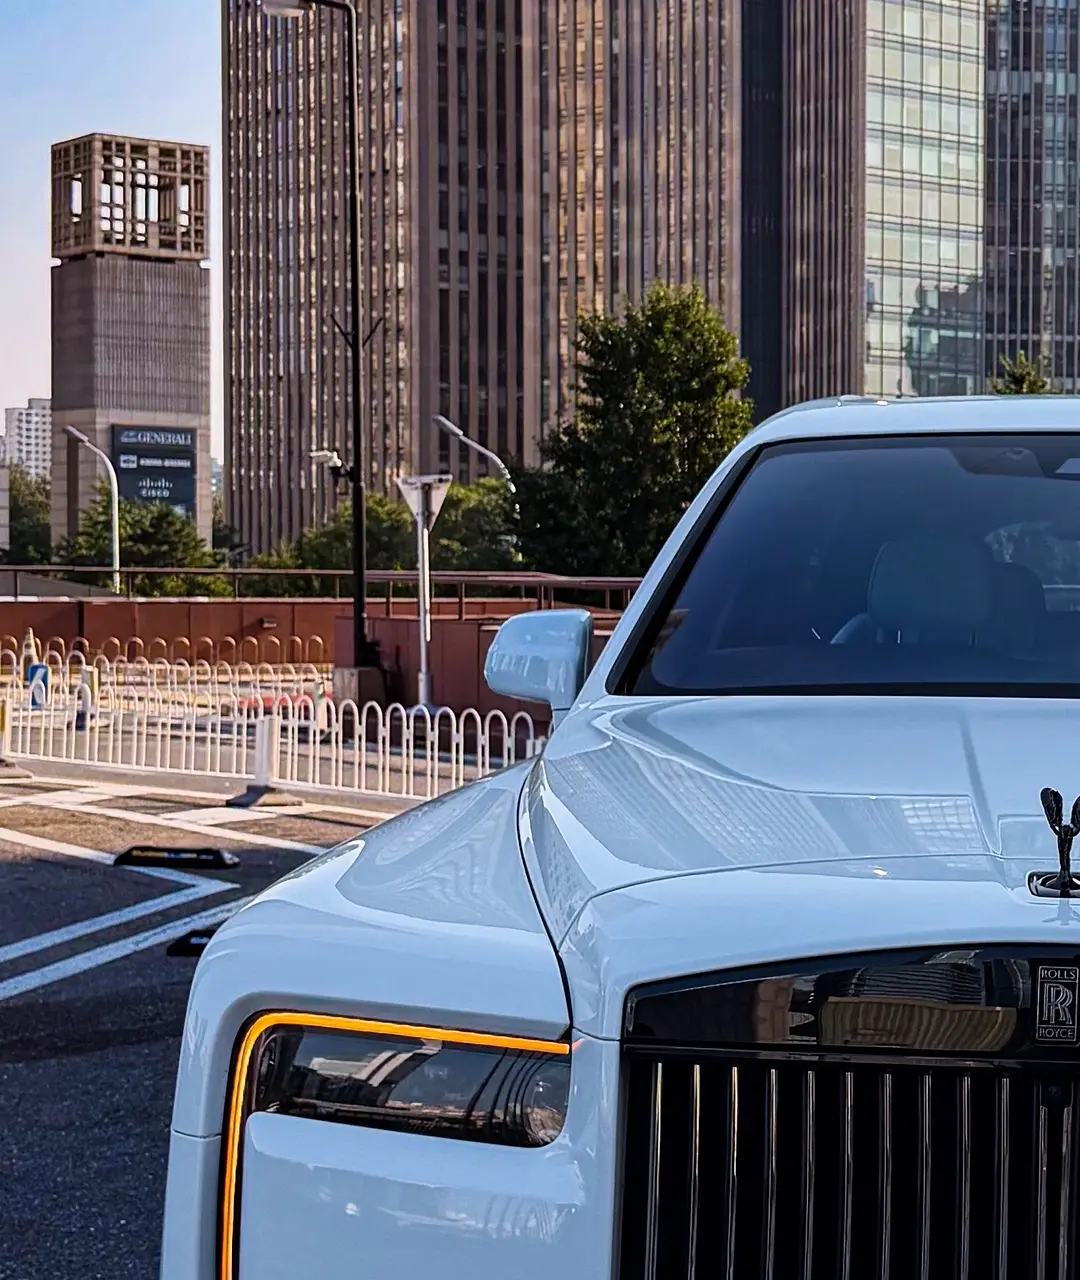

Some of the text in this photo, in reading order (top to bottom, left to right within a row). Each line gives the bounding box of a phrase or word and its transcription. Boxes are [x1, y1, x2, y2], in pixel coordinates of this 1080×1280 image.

[138, 430, 191, 445] GENERALI
[1041, 969, 1076, 980] ROLLS
[1039, 1028, 1074, 1038] ROYCE
